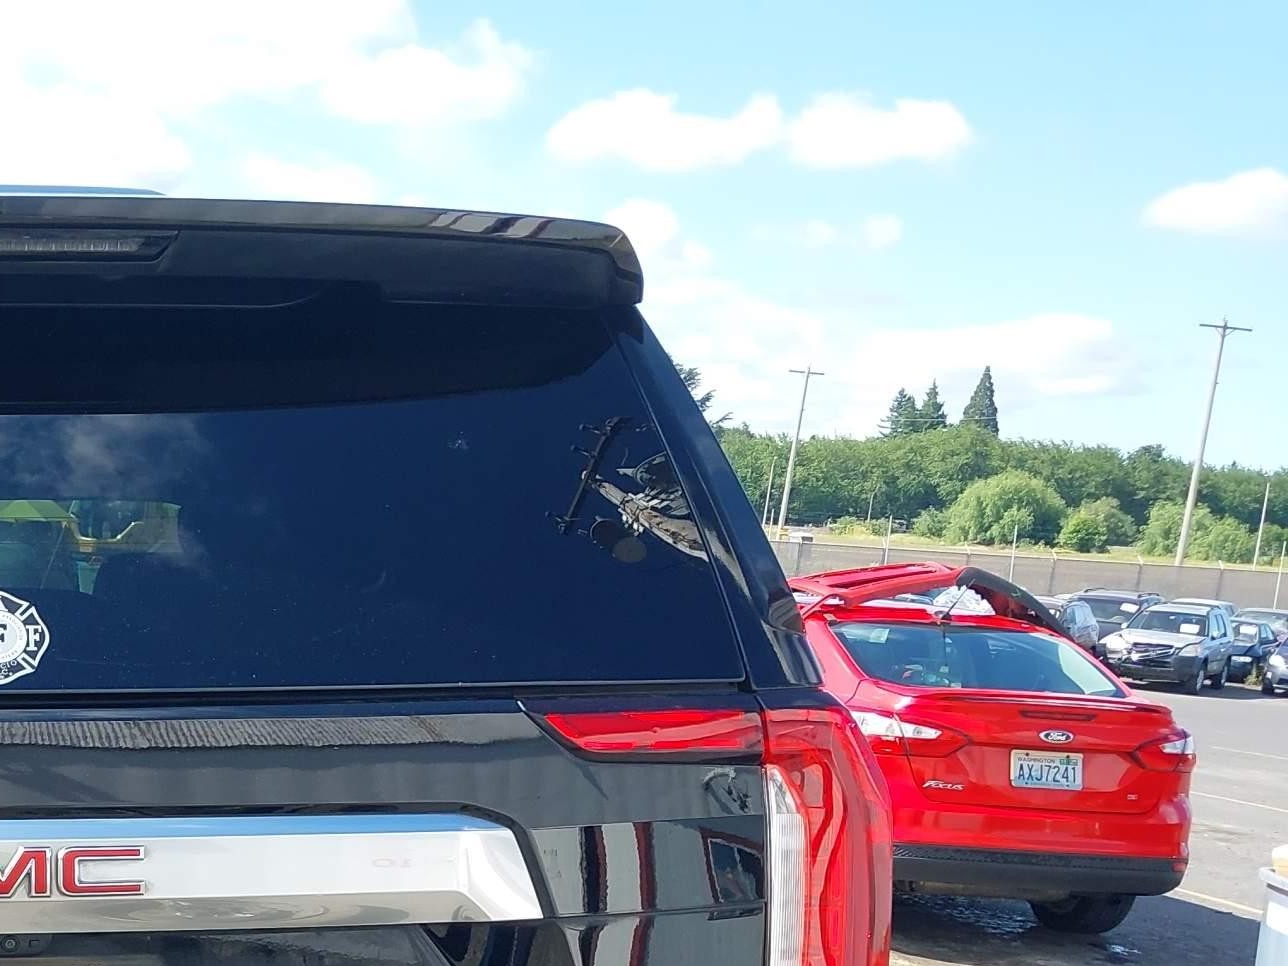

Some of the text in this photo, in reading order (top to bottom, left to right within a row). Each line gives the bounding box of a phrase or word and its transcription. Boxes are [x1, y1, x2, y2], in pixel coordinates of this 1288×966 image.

[26, 624, 42, 651] F
[1017, 756, 1056, 765] WASHINGTON
[1018, 763, 1077, 784] AXJ7241
